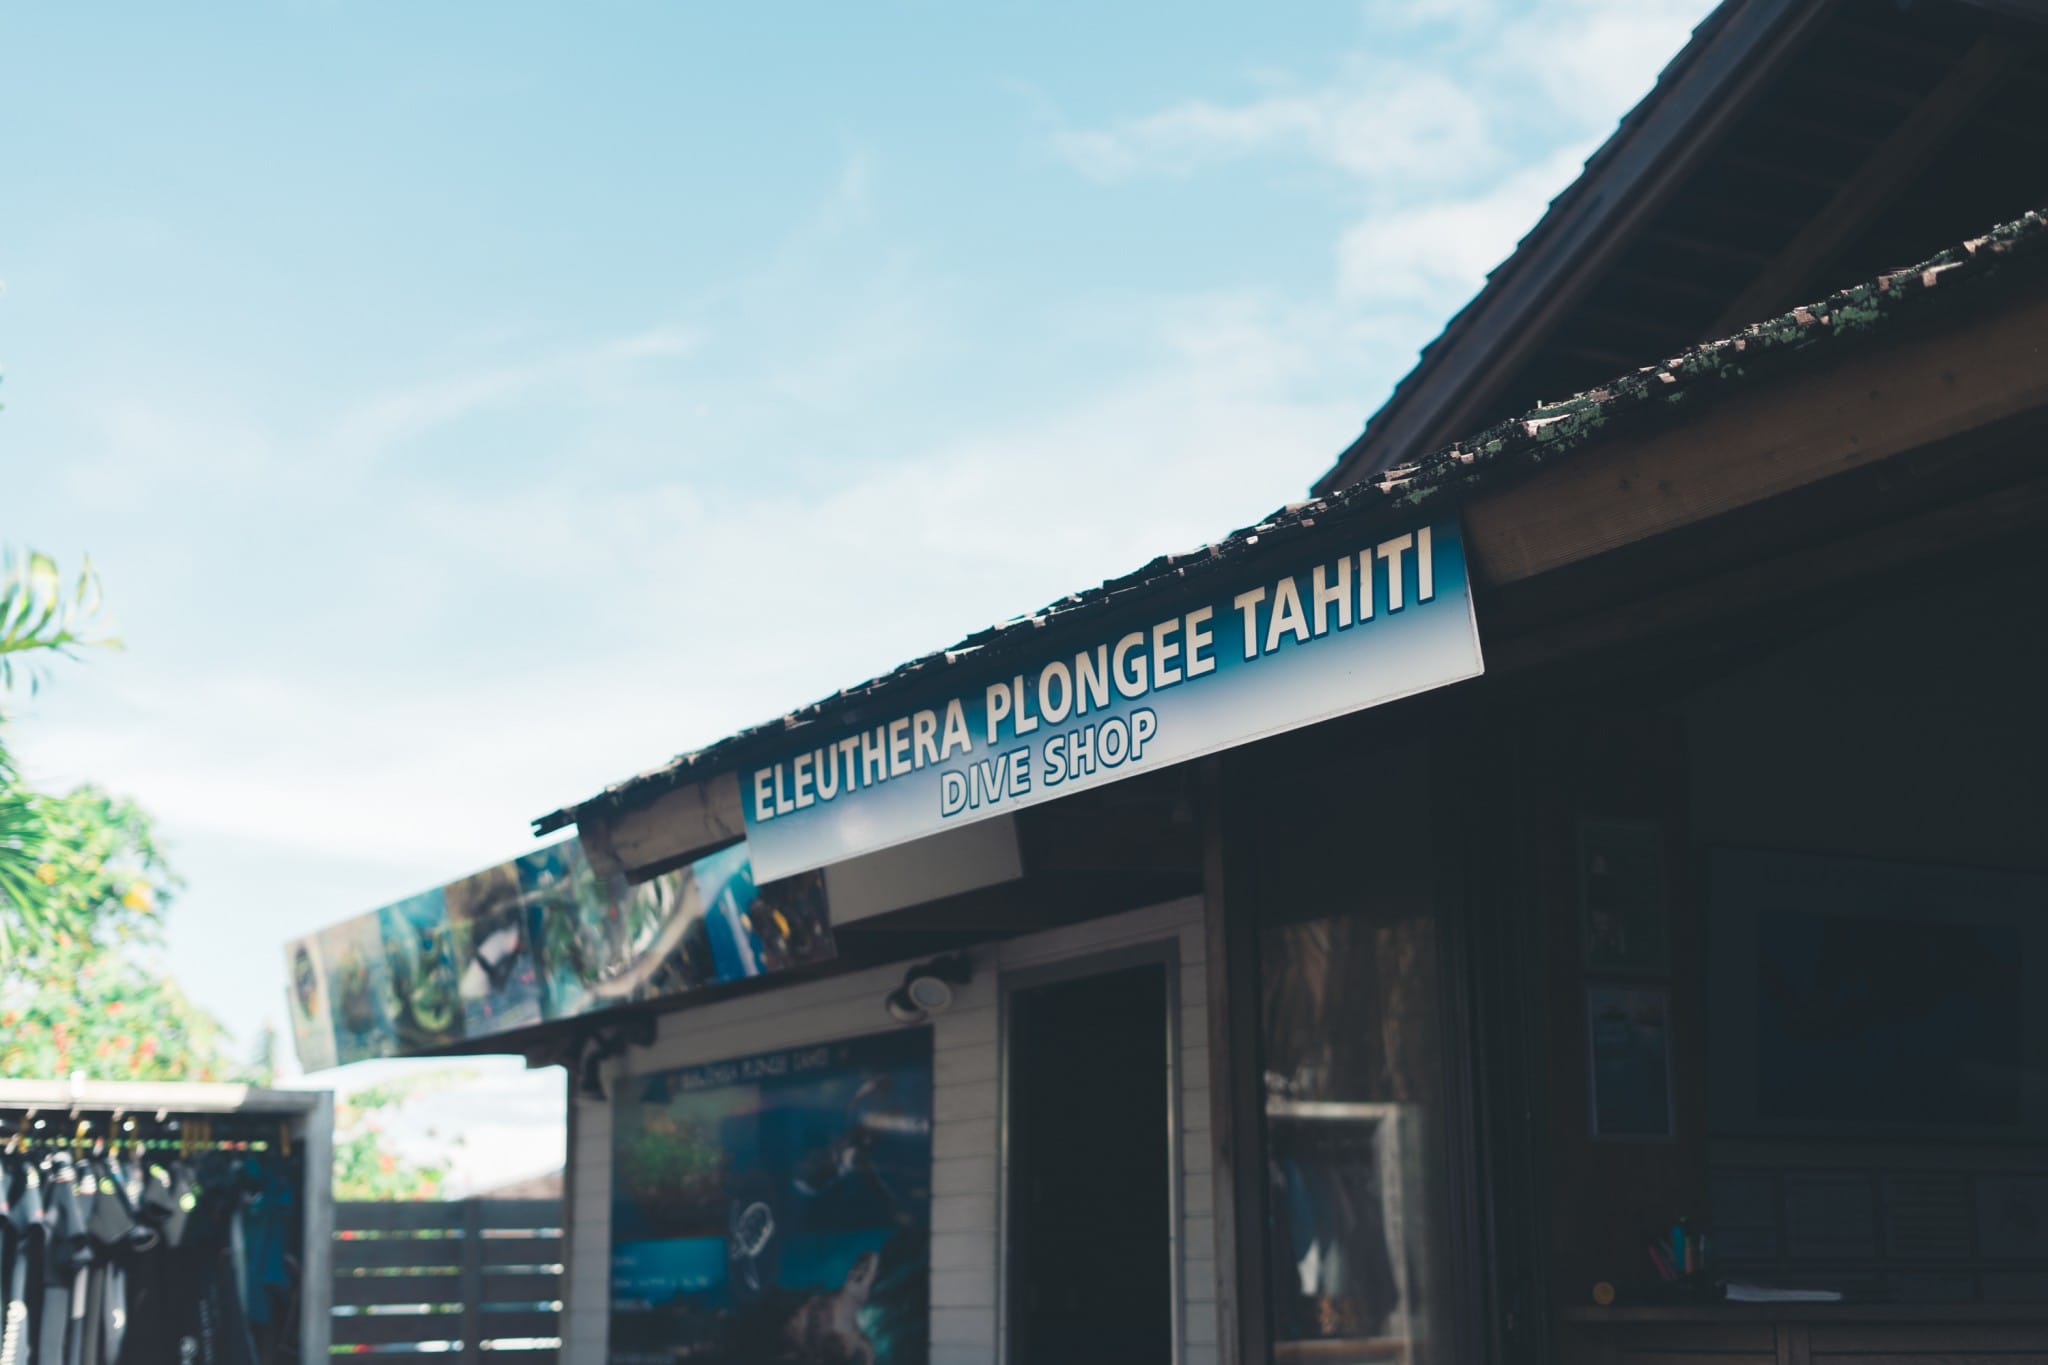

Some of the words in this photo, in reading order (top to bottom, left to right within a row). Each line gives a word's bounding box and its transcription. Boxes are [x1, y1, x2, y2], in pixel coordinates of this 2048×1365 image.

[752, 698, 973, 822] ELEUTHERA
[985, 606, 1216, 744] PLONGEE
[1234, 526, 1436, 660] TAHITI
[940, 749, 1032, 817] DIVE
[1043, 707, 1159, 786] SHOP
